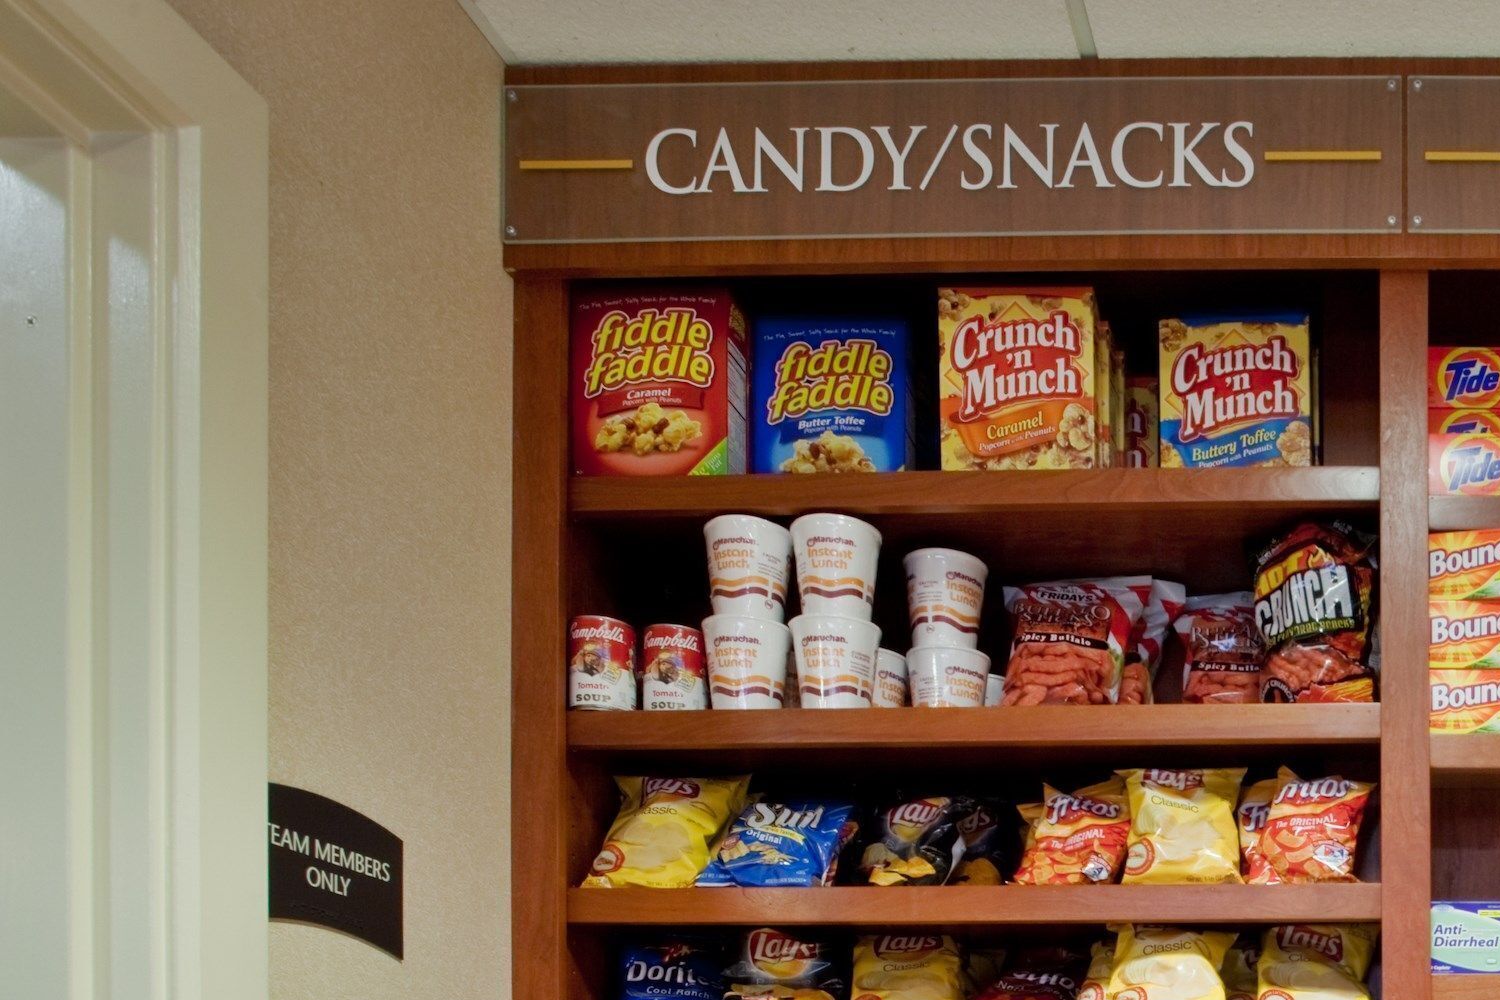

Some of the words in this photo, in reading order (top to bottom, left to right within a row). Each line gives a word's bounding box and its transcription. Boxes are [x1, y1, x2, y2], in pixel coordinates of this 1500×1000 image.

[645, 120, 1255, 194] CANDY/SNACKS
[595, 311, 709, 353] fiddle
[953, 314, 1075, 369] Crunch
[780, 343, 889, 383] fiddle
[1006, 350, 1032, 368] 'n
[1174, 340, 1292, 393] Crunch
[587, 345, 710, 393] faddle
[964, 358, 1077, 415] Munch
[1225, 372, 1250, 391] 'n
[1445, 359, 1500, 401] Tide
[622, 397, 645, 406] Popcorn
[626, 387, 672, 400] Caramel
[771, 375, 889, 421] faddle
[1184, 380, 1294, 436] Munch
[798, 418, 831, 430] Butter
[834, 416, 865, 426] Toffee
[986, 411, 1043, 440] Caramel
[979, 436, 1010, 452] Popcorn
[1025, 426, 1056, 440] Peanuts
[1192, 441, 1237, 462] Buttery
[1240, 429, 1277, 446] Toffee
[1198, 457, 1229, 468] Popcorn
[1243, 444, 1273, 458] Peanuts
[814, 536, 856, 547] Maruchan
[714, 548, 758, 560] Instant
[808, 548, 854, 560] Instant
[718, 559, 750, 570] Lunch
[812, 560, 848, 570] Lunch
[950, 592, 978, 610] Lunch
[1255, 565, 1353, 638] CRUNCH
[718, 635, 760, 646] Maruchan
[807, 634, 848, 644] Maruchan
[1050, 633, 1092, 646] Buffalo
[806, 658, 840, 668] Lunch
[1198, 662, 1226, 671] Spicy
[576, 693, 611, 702] SOUP
[950, 686, 980, 702] Lunch
[1046, 794, 1120, 824] Fritos
[1151, 795, 1199, 814] Classic
[1290, 814, 1337, 826] ORIGINAL
[746, 830, 782, 844] Original
[315, 839, 390, 882] MEMBERS
[306, 866, 350, 896] ONLY
[1434, 924, 1466, 935] Anti-
[1143, 940, 1192, 956] Classic
[1434, 936, 1499, 948] Diarrheal
[883, 960, 930, 972] Classic
[646, 986, 672, 995] Cool
[676, 988, 710, 1000] Ranch
